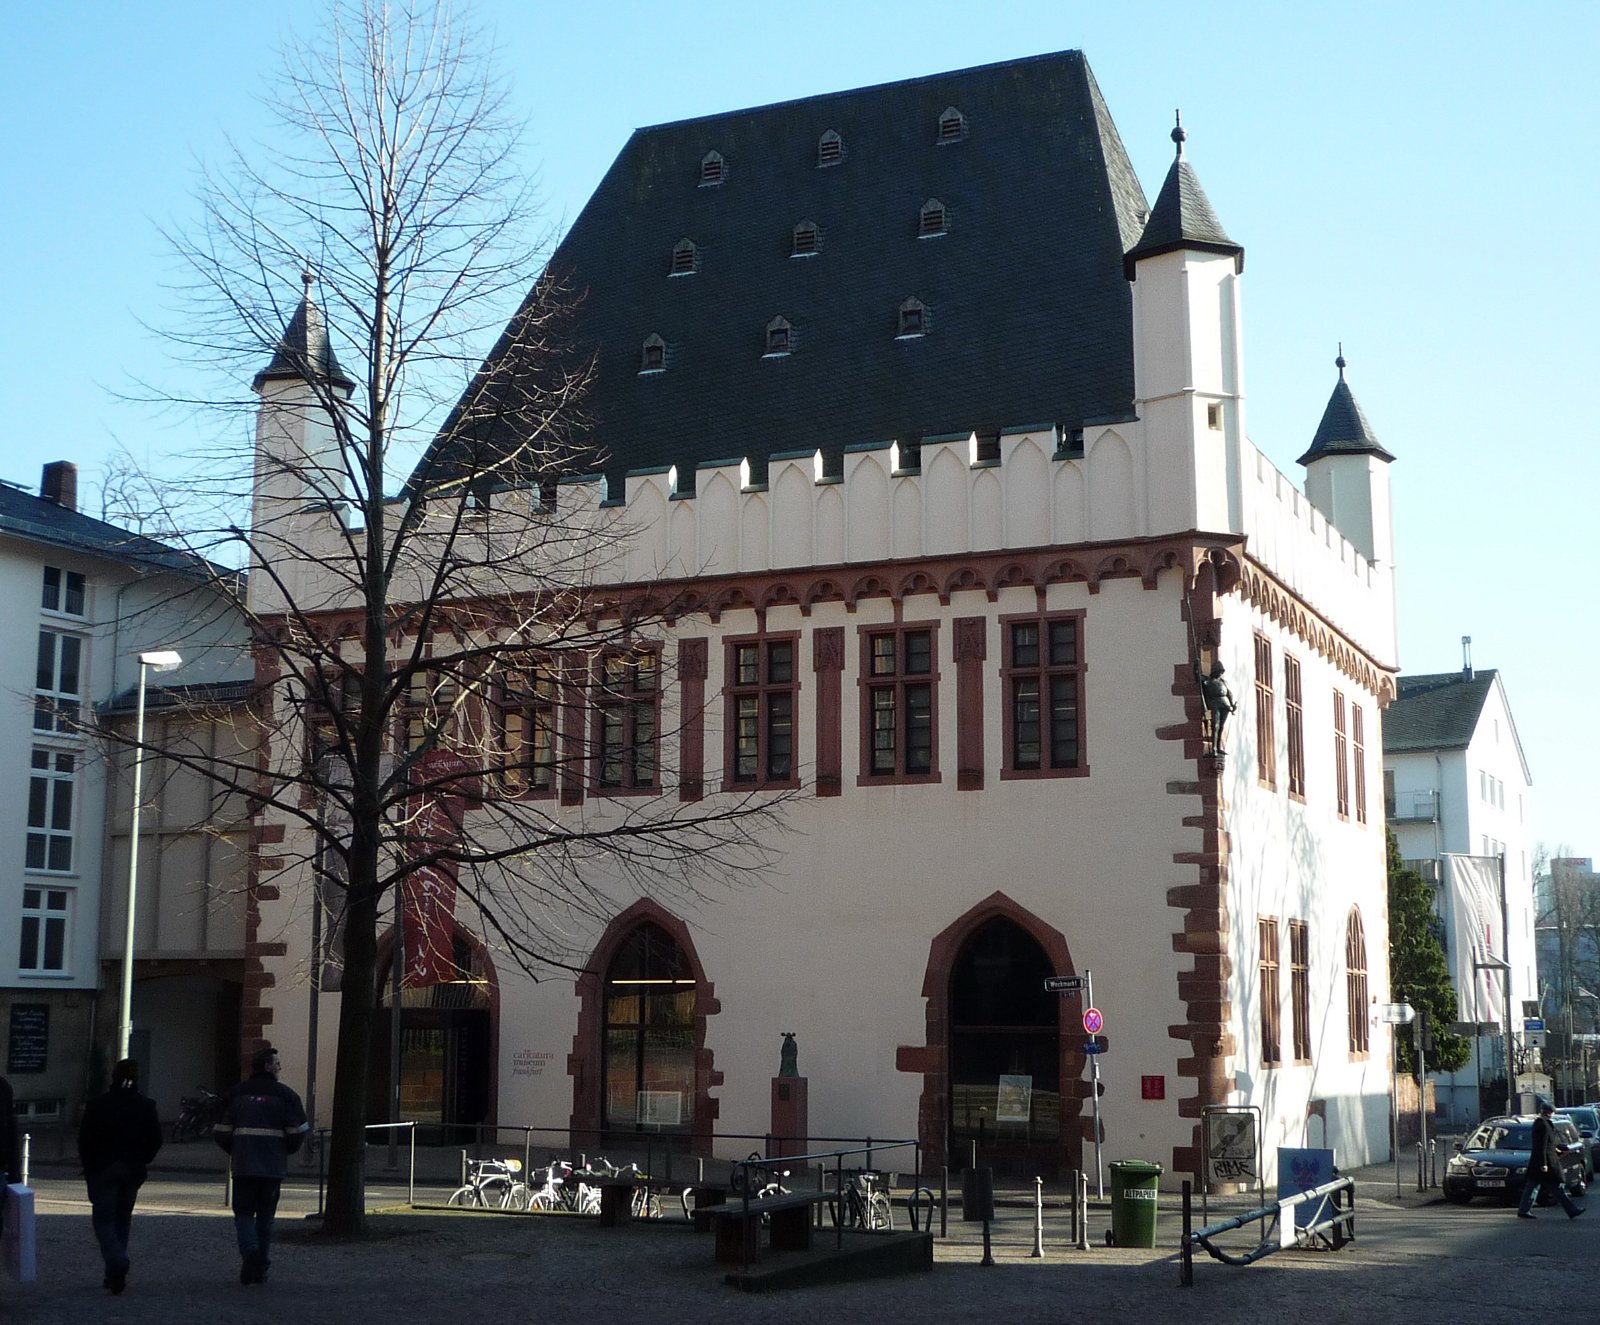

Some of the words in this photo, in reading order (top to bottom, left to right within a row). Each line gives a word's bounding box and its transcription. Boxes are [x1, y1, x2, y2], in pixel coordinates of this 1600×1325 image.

[1050, 979, 1077, 988] Weckmarkt
[513, 1050, 554, 1059] caricatura
[512, 1066, 543, 1076] frankfurt
[1125, 1189, 1156, 1199] ALTPAPIER
